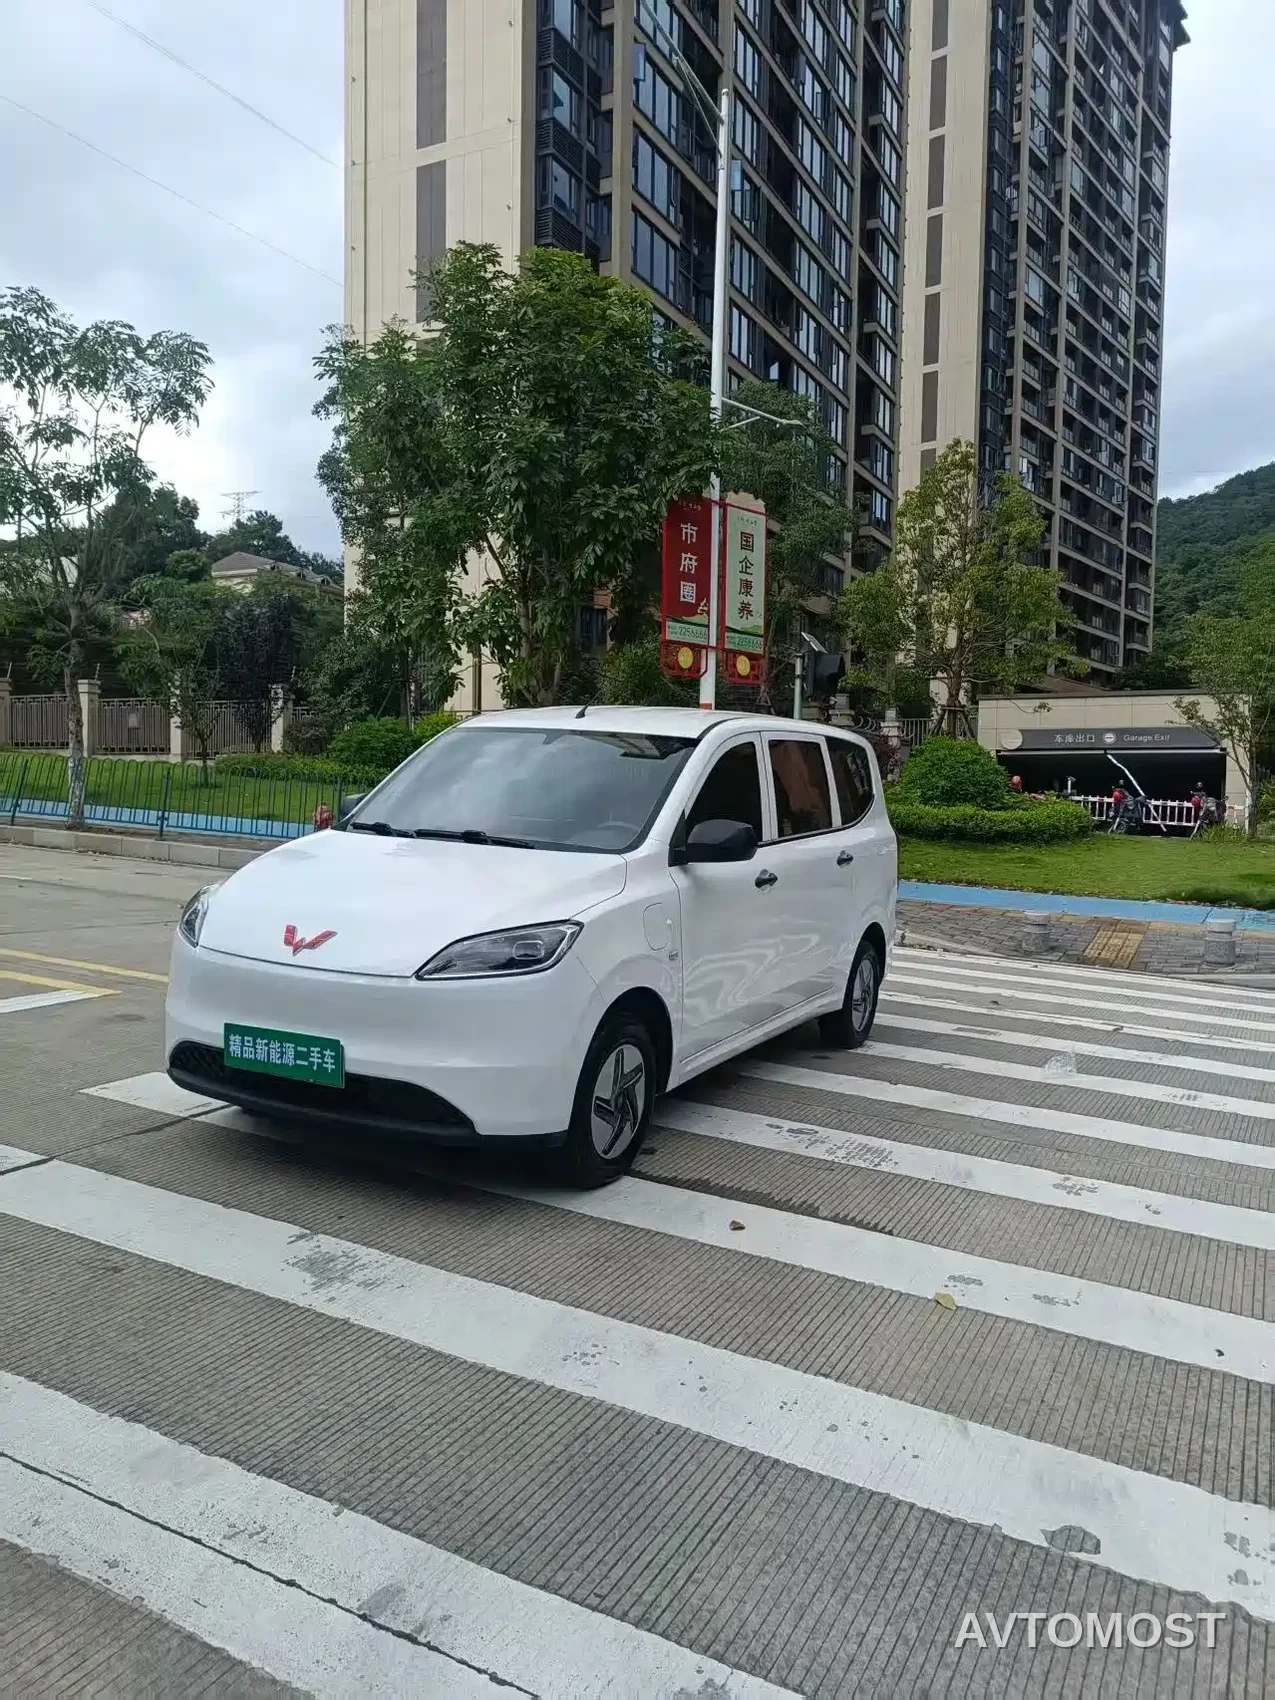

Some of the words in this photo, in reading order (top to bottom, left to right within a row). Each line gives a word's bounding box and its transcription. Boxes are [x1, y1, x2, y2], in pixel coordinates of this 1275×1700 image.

[738, 531, 755, 620] 国企康养
[1054, 733, 1095, 744] 车库出口
[1123, 733, 1153, 743] Garage
[229, 1033, 336, 1073] 精品新能源二手车
